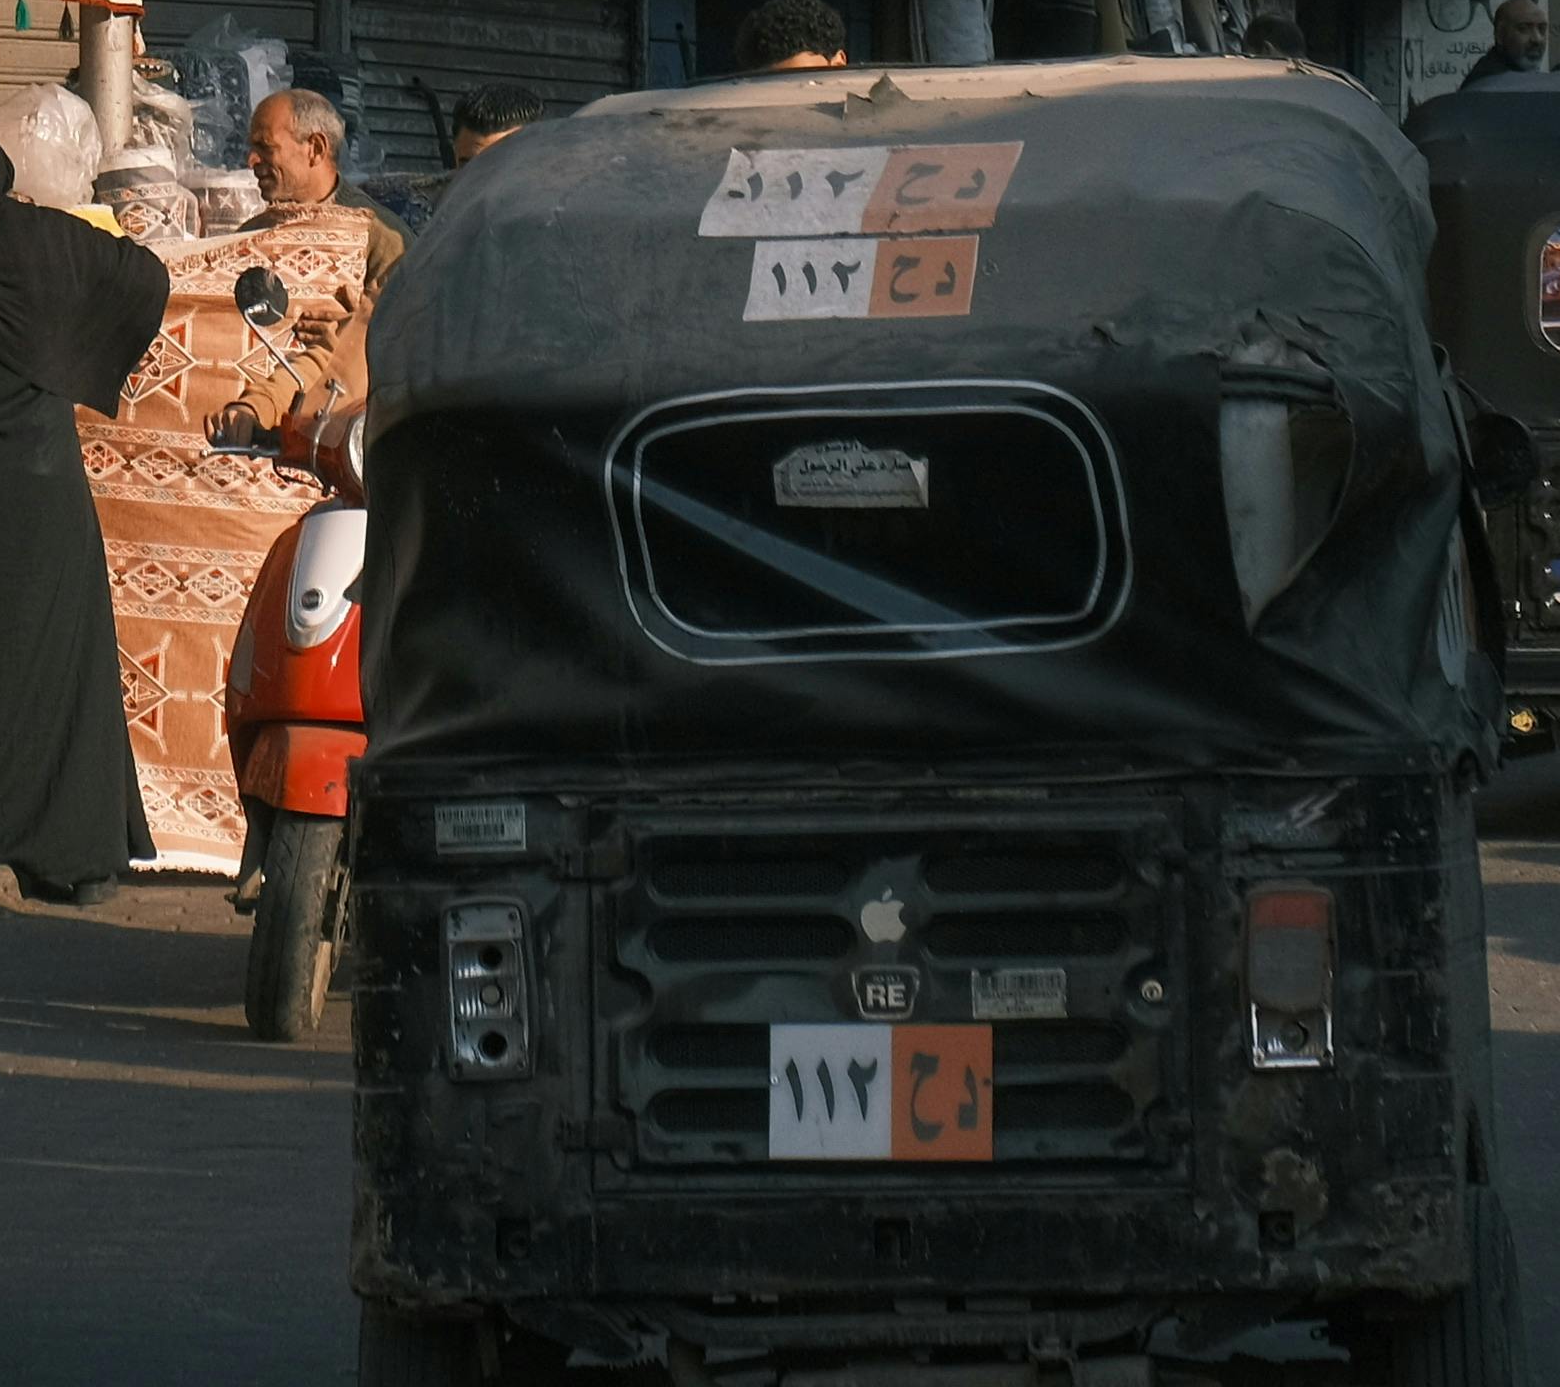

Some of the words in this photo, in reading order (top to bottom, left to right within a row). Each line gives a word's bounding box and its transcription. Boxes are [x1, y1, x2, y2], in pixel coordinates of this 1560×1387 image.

[770, 258, 863, 297] ١١٢
[866, 984, 906, 1009] RE
[784, 1055, 879, 1124] ١١٢
